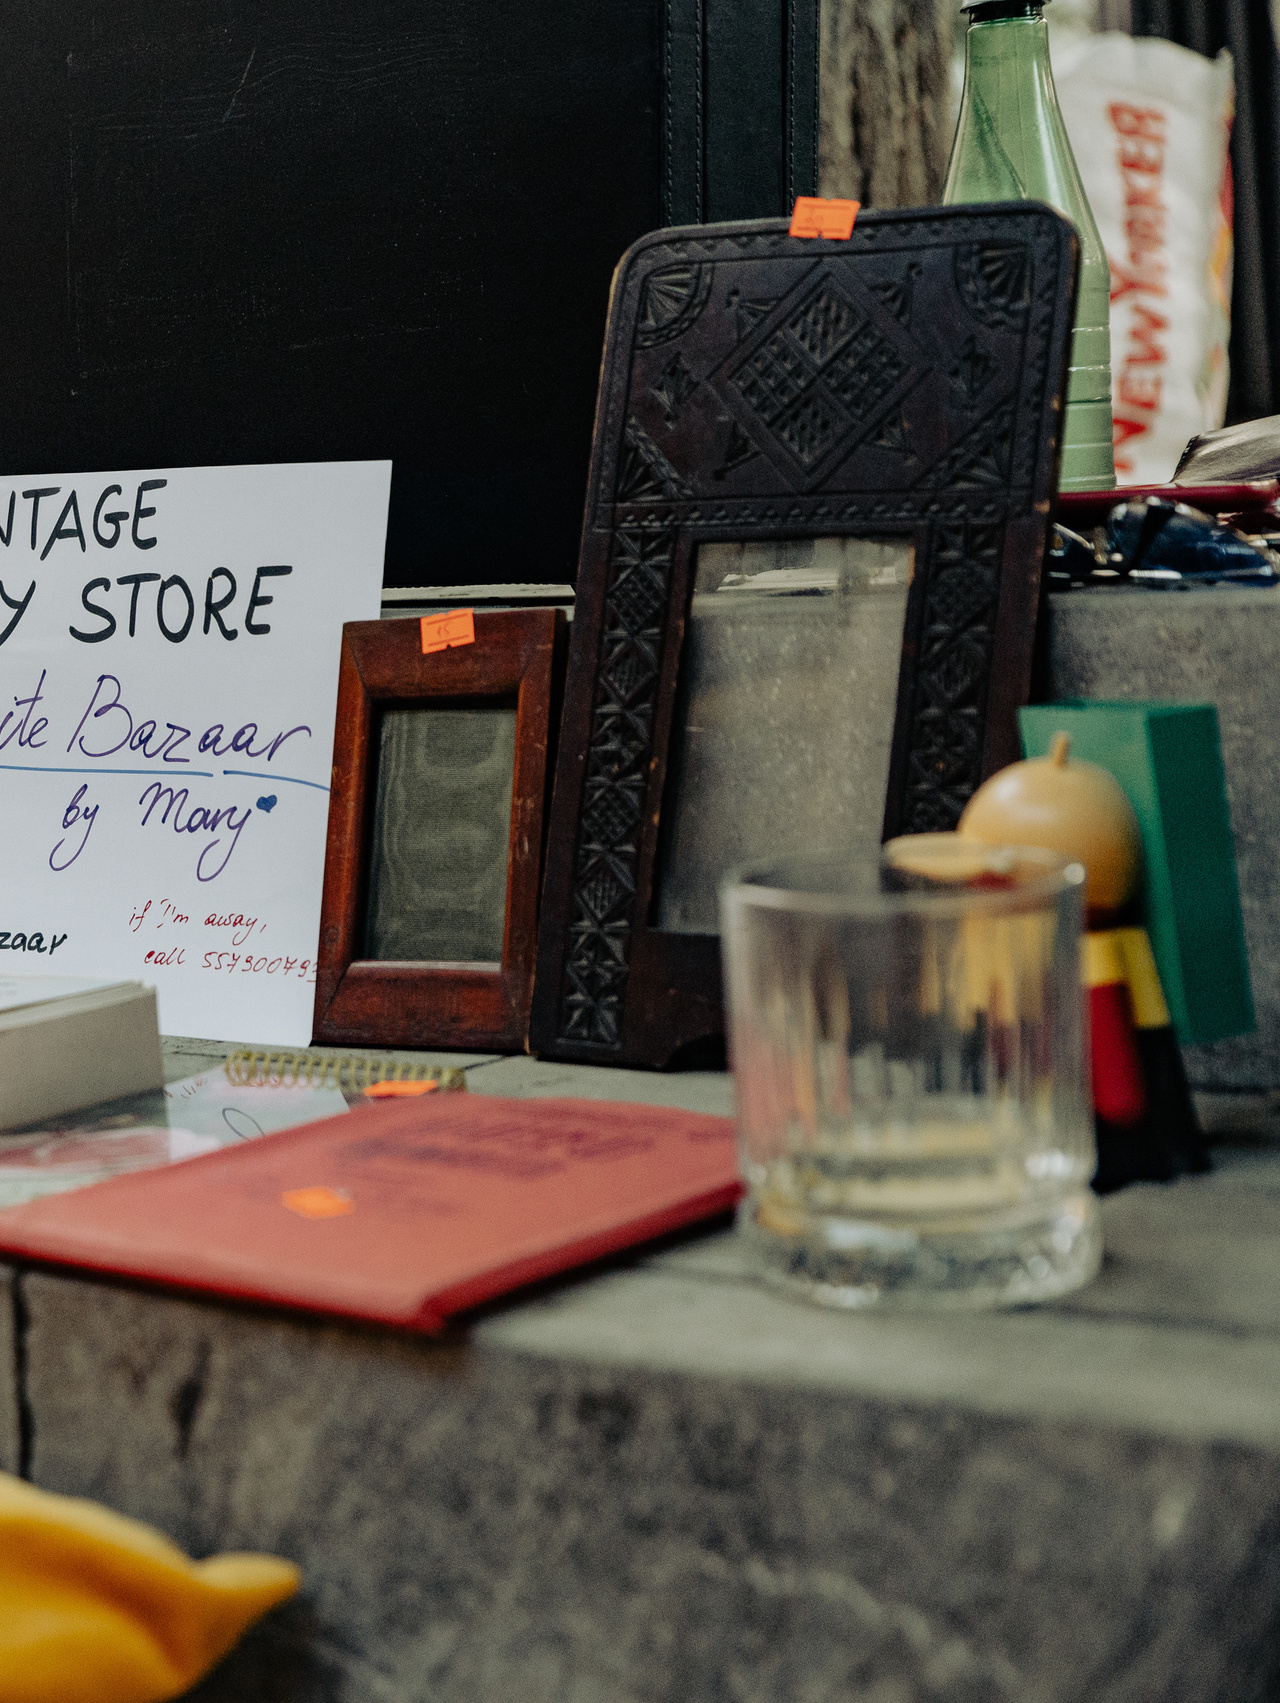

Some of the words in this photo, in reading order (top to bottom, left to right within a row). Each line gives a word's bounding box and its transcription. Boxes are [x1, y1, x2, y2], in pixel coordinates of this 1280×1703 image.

[69, 564, 293, 644] STORE
[67, 674, 313, 765] Bazaar
[49, 783, 100, 872] by
[139, 782, 252, 882] Mary
[128, 899, 153, 933] if
[156, 898, 189, 929] I'm
[203, 912, 267, 947] away,
[143, 946, 186, 966] call
